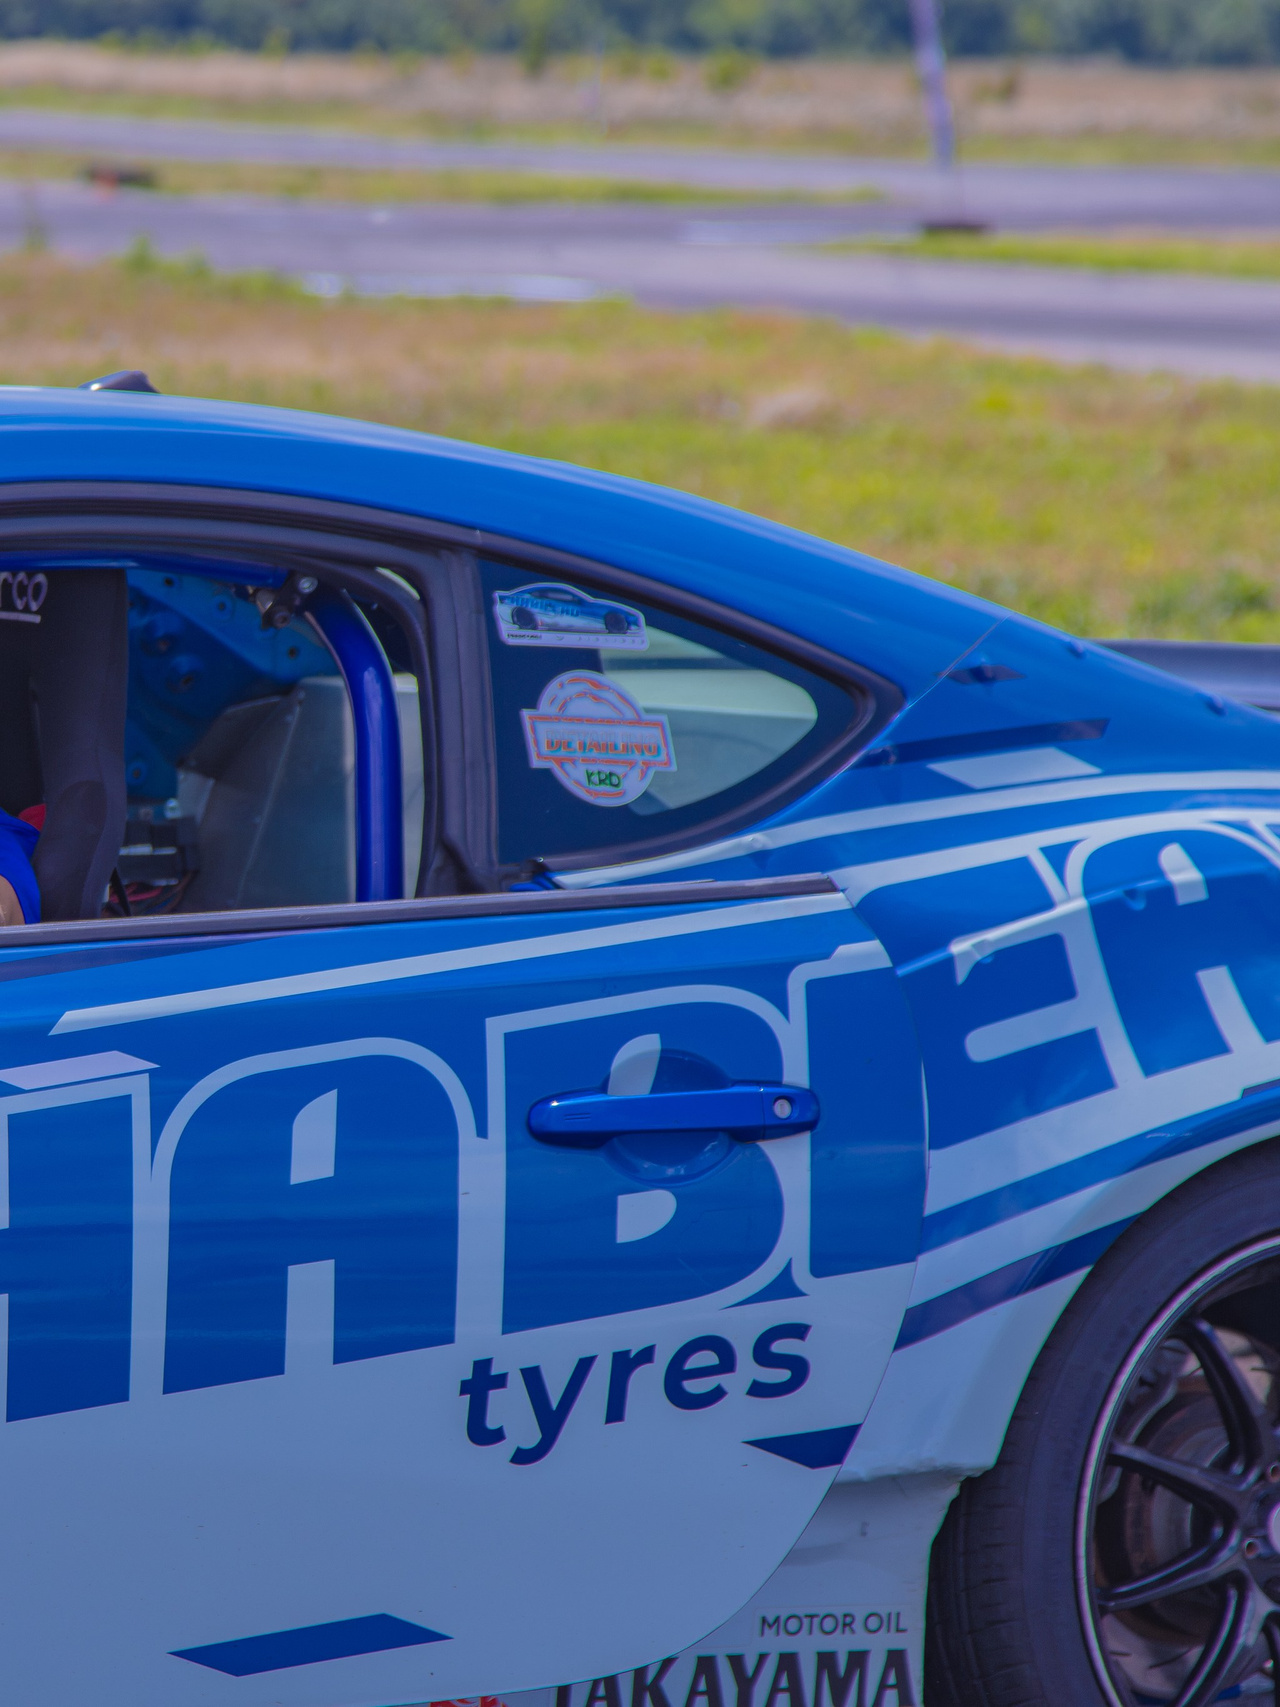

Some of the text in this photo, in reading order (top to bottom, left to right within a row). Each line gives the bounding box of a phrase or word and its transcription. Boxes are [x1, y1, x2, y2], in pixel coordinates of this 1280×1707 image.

[545, 728, 659, 756] DETAILING
[585, 769, 622, 788] KRD
[458, 1322, 813, 1466] tyres
[759, 1611, 908, 1638] MOTOR OIL
